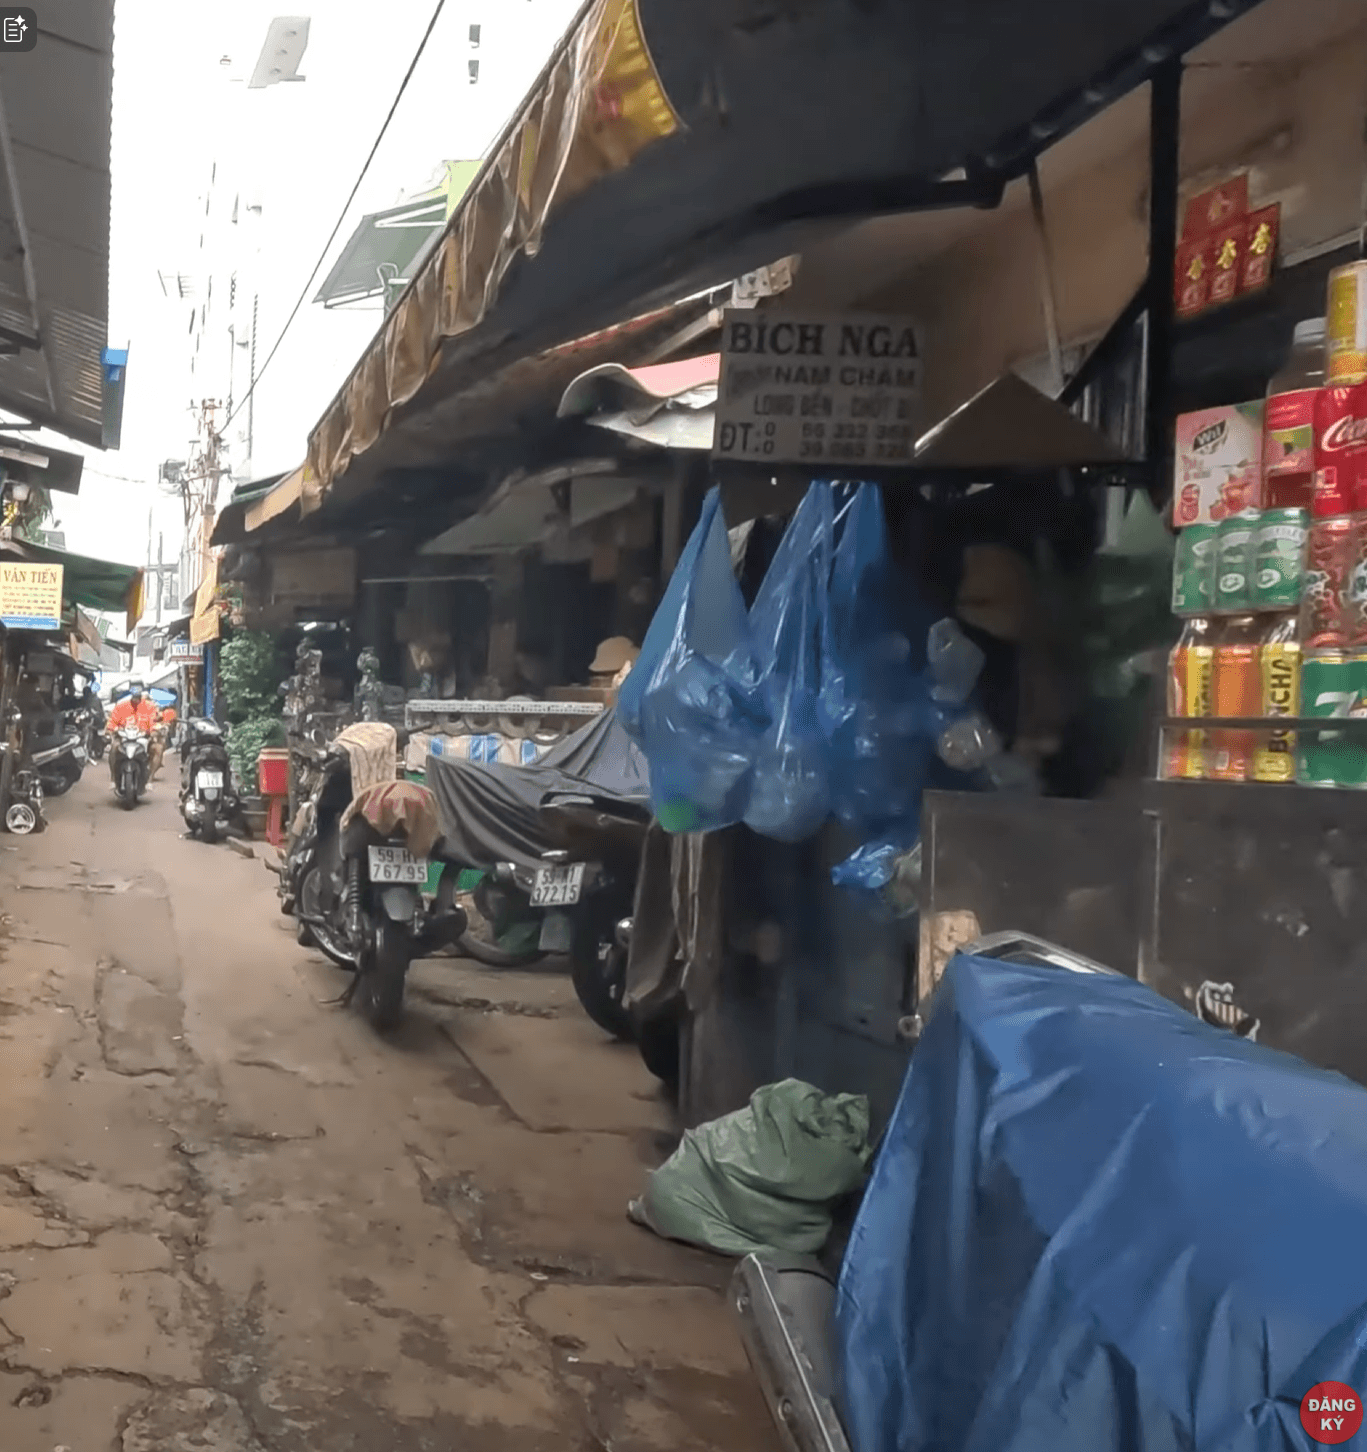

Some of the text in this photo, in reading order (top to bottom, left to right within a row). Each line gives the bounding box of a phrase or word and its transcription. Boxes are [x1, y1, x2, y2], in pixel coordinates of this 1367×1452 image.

[728, 314, 919, 358] BÍCH NGA
[775, 365, 831, 385] NAM
[4, 567, 58, 584] VĂN TIẾN
